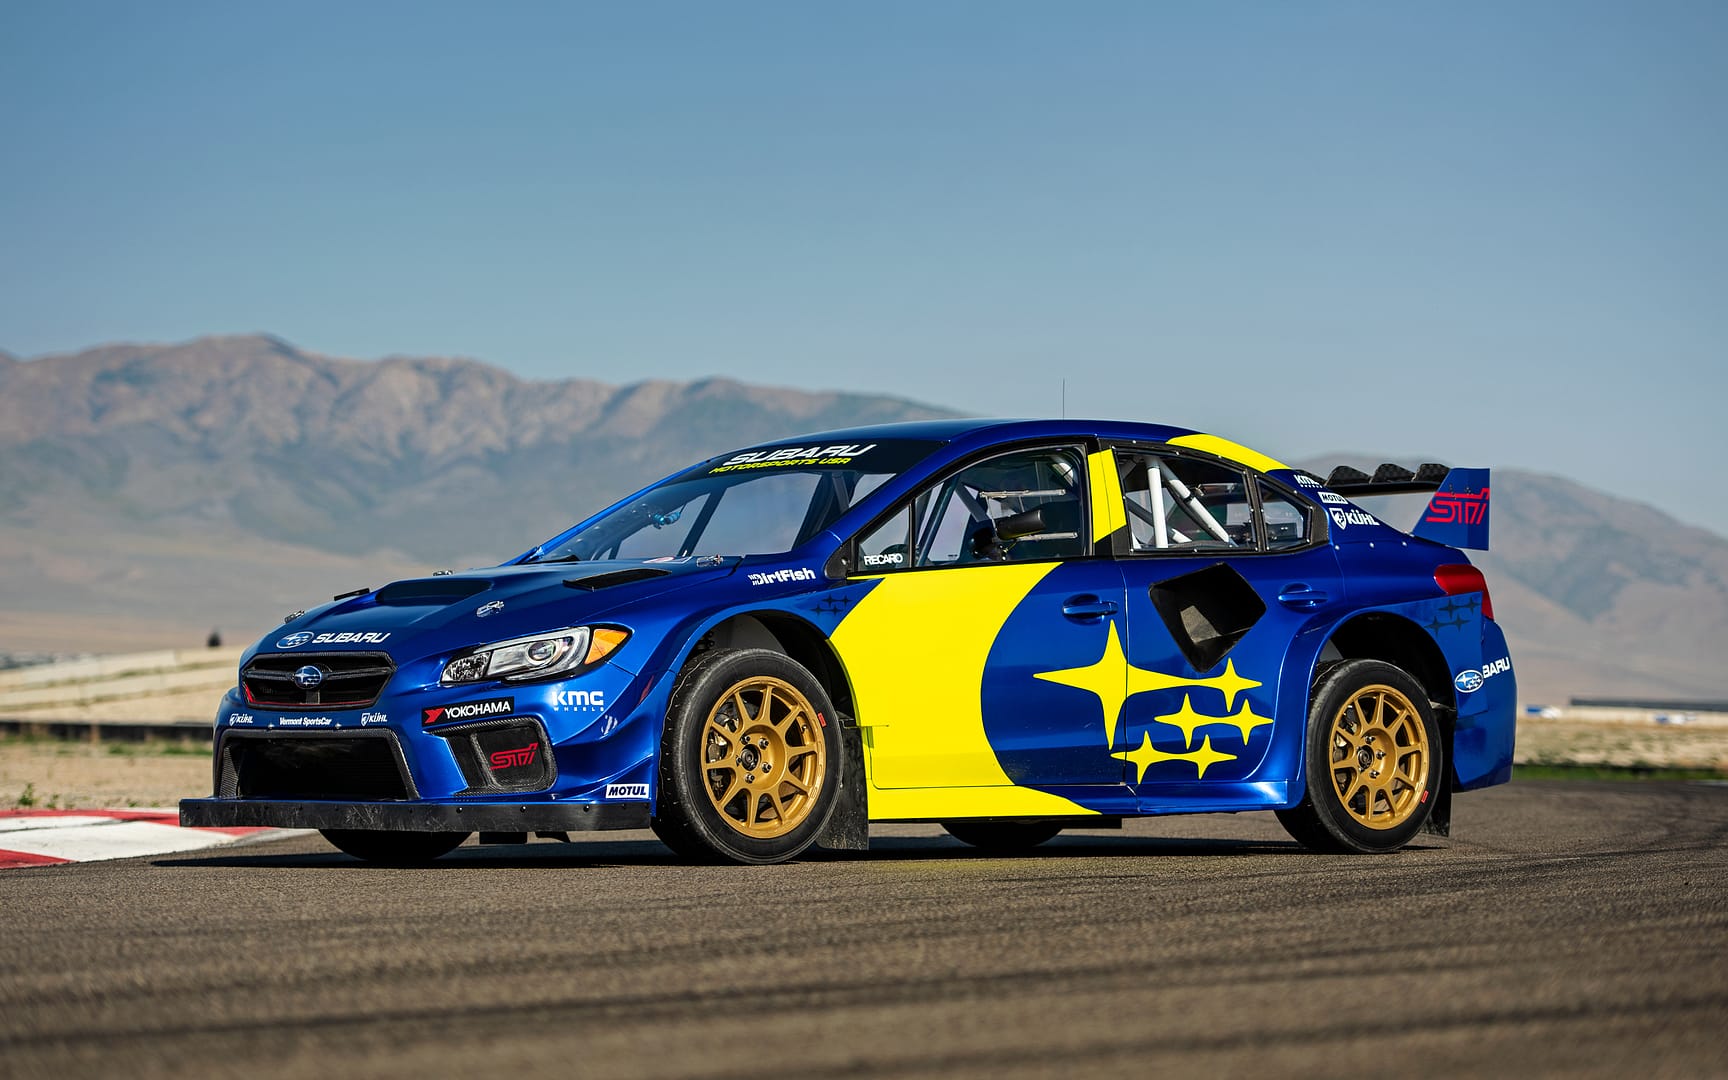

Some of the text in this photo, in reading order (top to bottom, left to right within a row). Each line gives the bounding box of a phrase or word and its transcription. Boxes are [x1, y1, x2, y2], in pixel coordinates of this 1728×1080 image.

[723, 444, 877, 466] SUBARU
[709, 457, 852, 474] MOTORSPORTS USA
[1345, 509, 1380, 525] KÜHL
[864, 553, 904, 566] RECARO
[748, 567, 816, 586] DirtFish
[312, 632, 391, 644] SUBARU
[1482, 656, 1511, 678] BARU
[445, 701, 512, 719] YOKOHAMA
[279, 717, 333, 727] Vermont SportsCar
[608, 786, 647, 796] MOTUL
